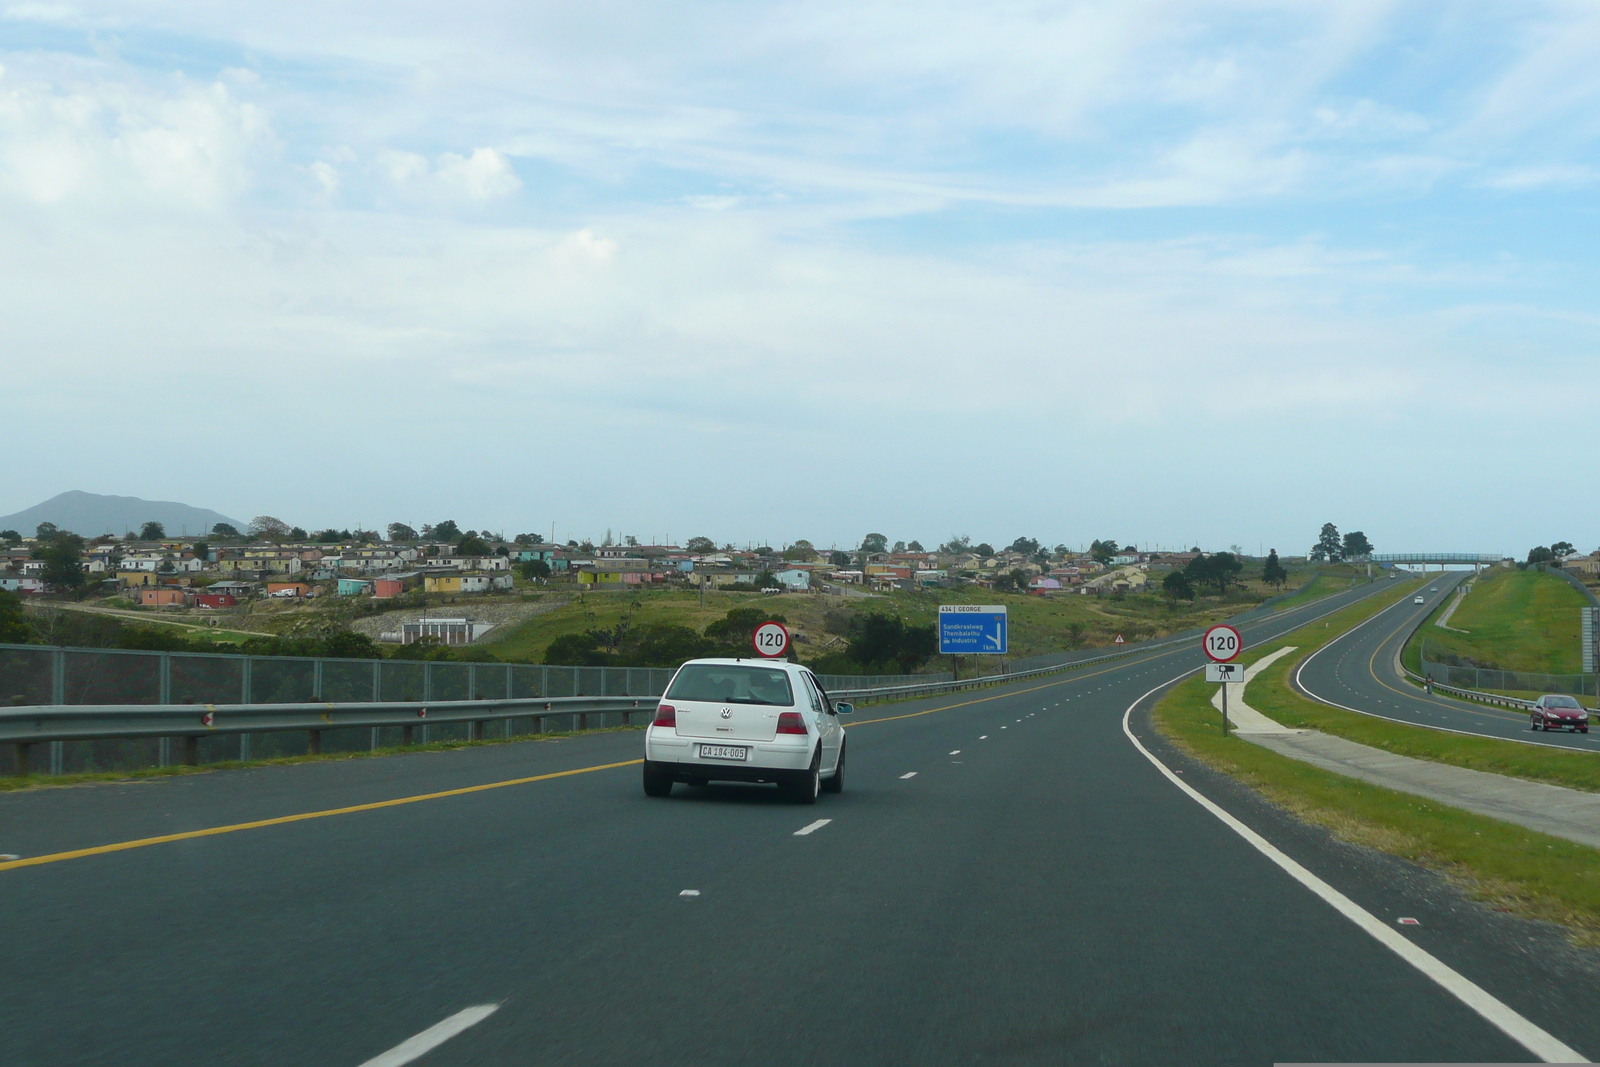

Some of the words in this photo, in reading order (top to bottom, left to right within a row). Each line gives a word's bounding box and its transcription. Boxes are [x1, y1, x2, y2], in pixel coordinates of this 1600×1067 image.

[759, 632, 783, 647] 120
[1209, 636, 1236, 651] 120
[702, 746, 712, 756] CA
